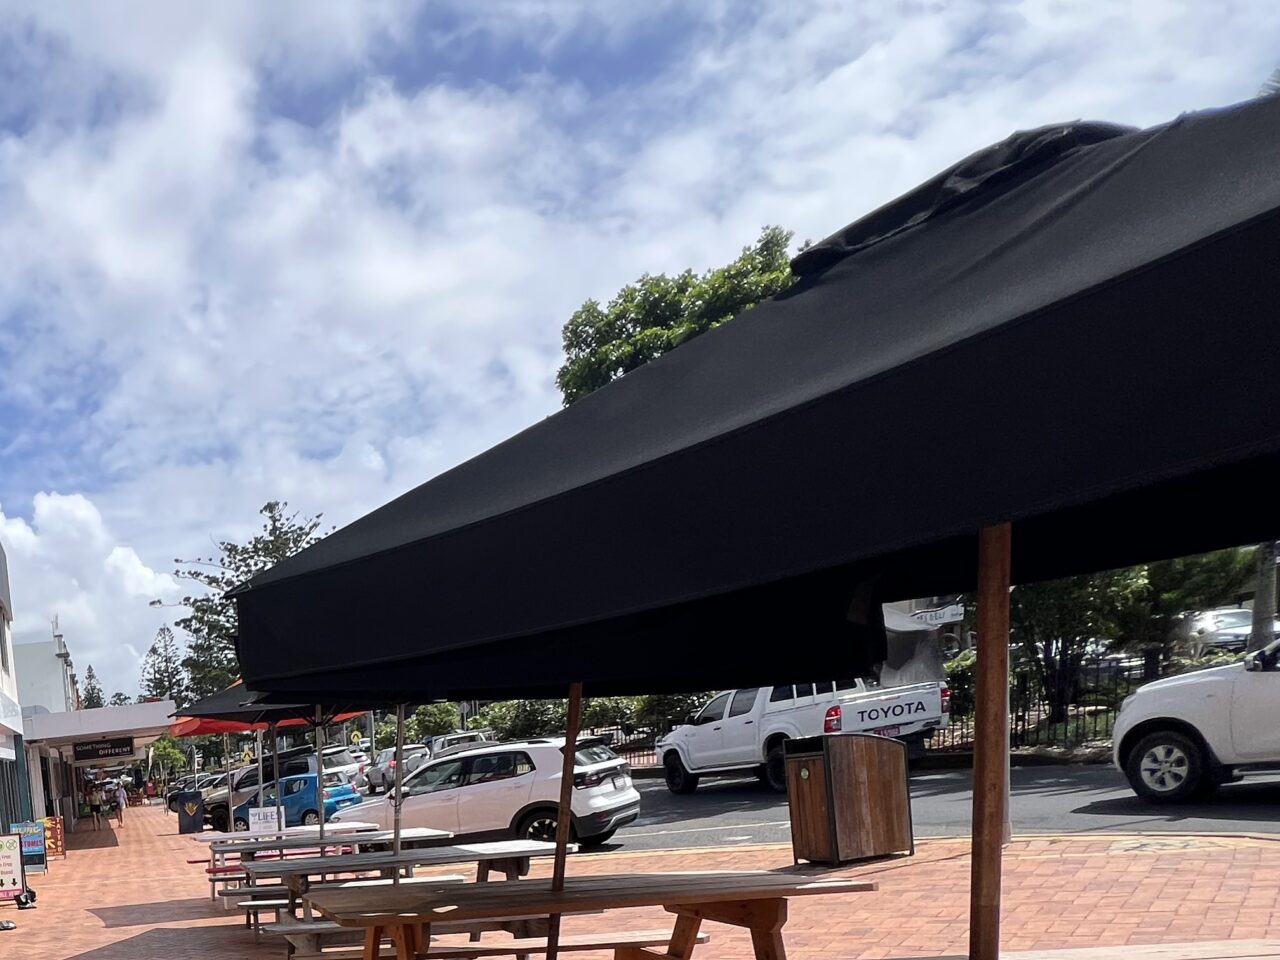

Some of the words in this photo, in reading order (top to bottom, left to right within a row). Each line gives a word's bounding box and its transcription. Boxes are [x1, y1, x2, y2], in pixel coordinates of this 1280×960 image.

[857, 701, 926, 722] TOYOTA
[76, 743, 111, 751] SOMETHING
[99, 746, 131, 755] DIFFERENT
